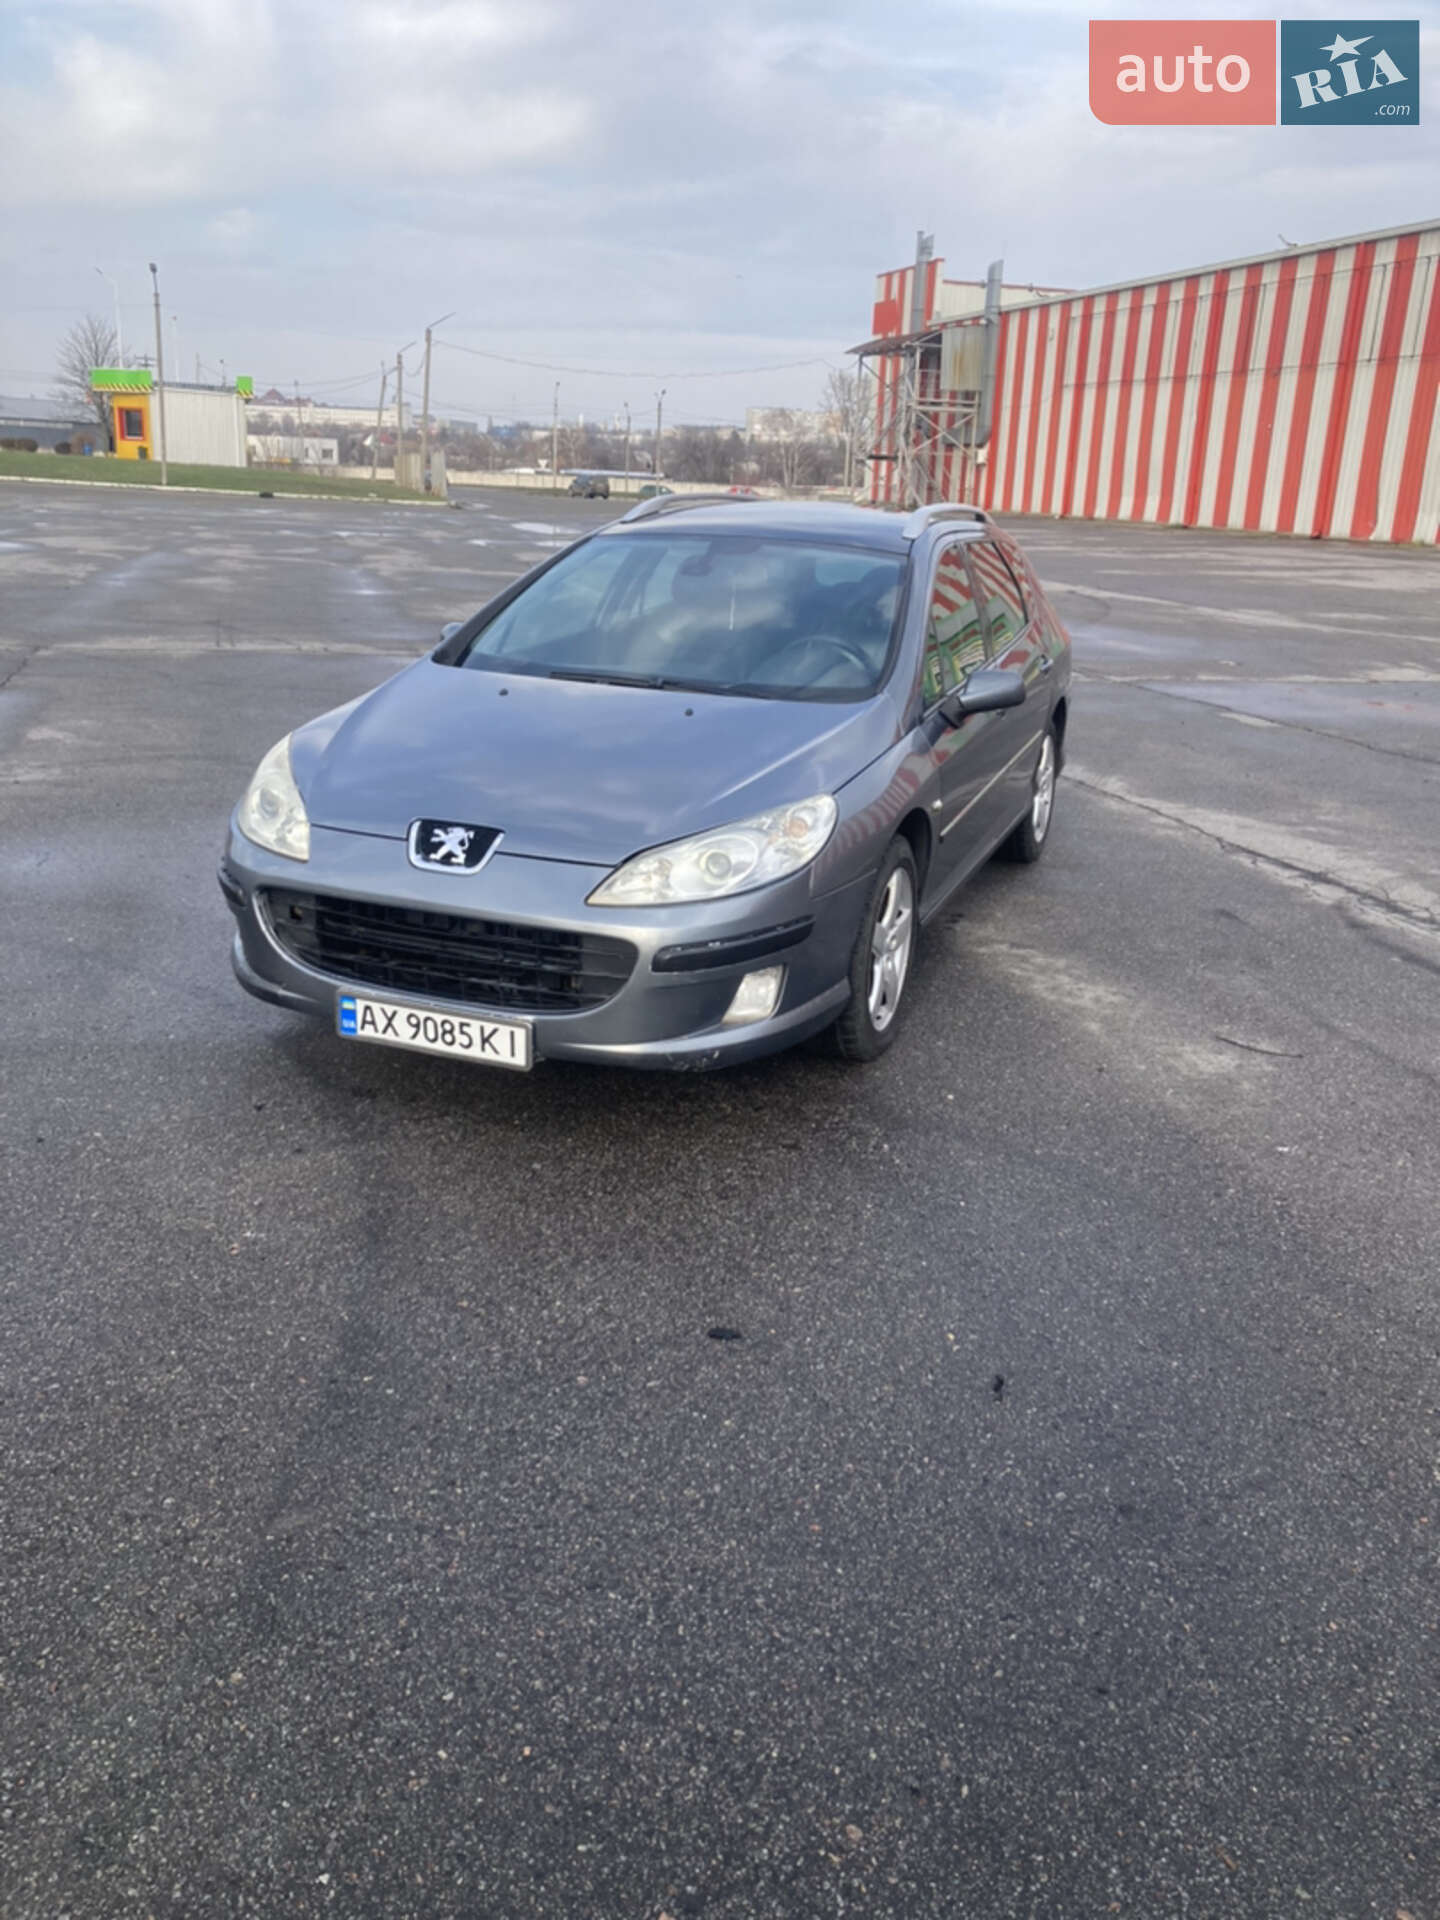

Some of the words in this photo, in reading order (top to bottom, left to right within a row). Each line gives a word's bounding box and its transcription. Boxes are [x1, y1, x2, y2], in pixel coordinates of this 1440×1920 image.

[360, 1005, 399, 1037] AX
[406, 1013, 473, 1049] 9085
[480, 1025, 515, 1058] KI
